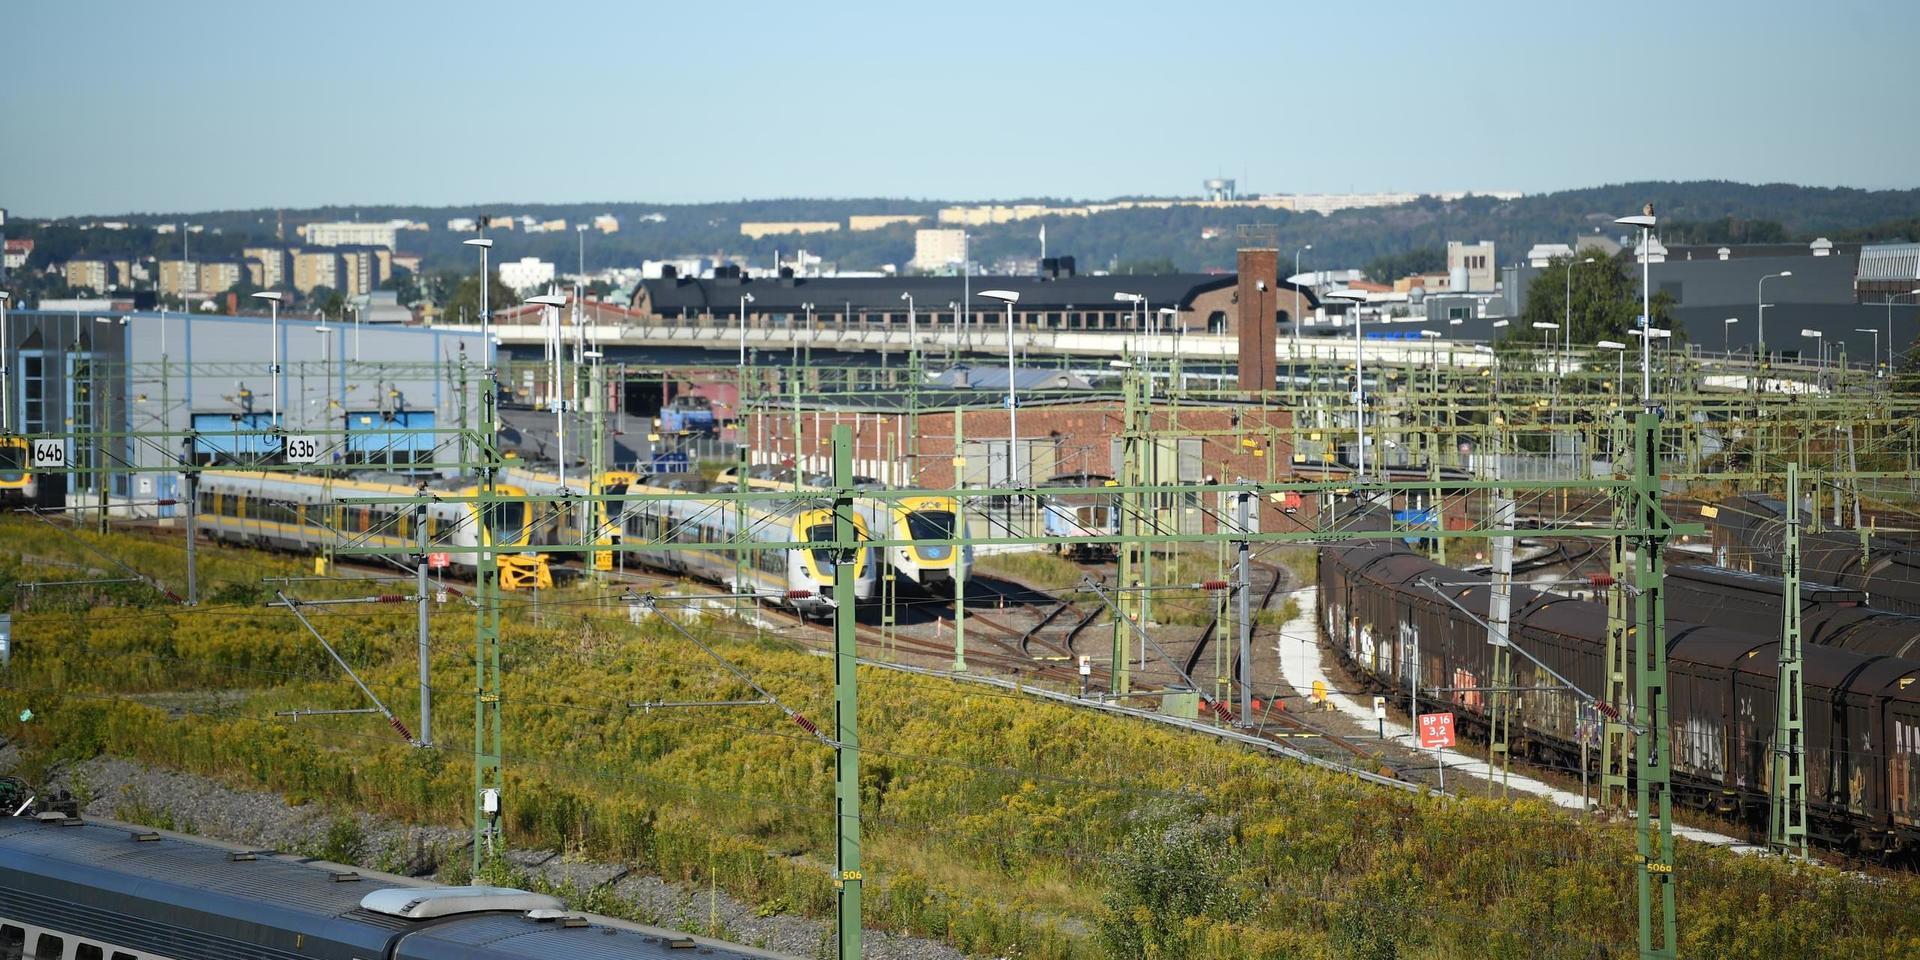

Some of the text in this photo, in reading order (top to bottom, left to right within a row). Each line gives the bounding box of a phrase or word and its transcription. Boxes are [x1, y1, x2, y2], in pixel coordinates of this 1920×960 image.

[37, 443, 62, 462] 64b
[289, 441, 314, 458] 63b
[1423, 716, 1450, 726] BP 16
[1429, 726, 1446, 736] 3,2
[1647, 863, 1672, 872] 506a
[843, 871, 862, 880] 506
